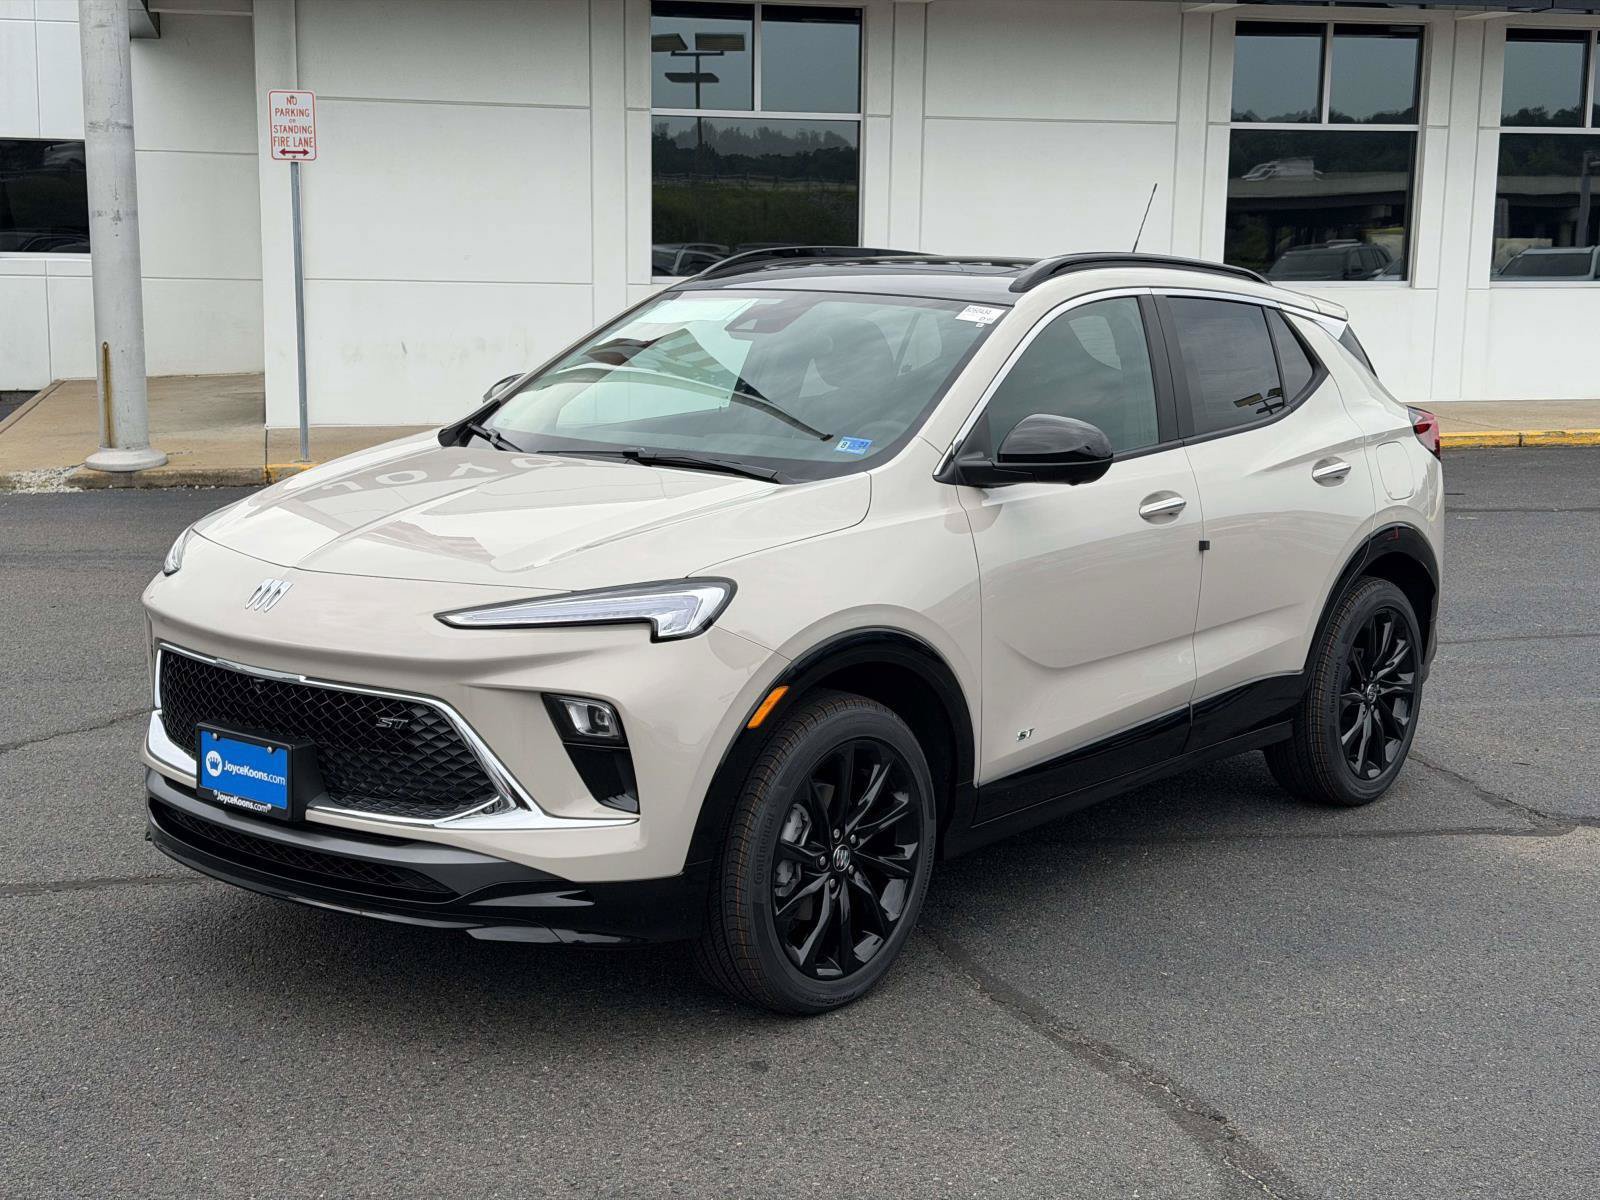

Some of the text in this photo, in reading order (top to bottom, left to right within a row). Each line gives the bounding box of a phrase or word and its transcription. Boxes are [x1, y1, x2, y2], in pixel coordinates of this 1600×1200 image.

[286, 97, 297, 105] NO
[275, 108, 309, 117] PARKING
[273, 125, 312, 134] STANDING
[273, 137, 313, 148] FIRE LANE
[223, 760, 286, 786] JoyceKoons.com
[216, 791, 268, 813] JoyceKoons.com
